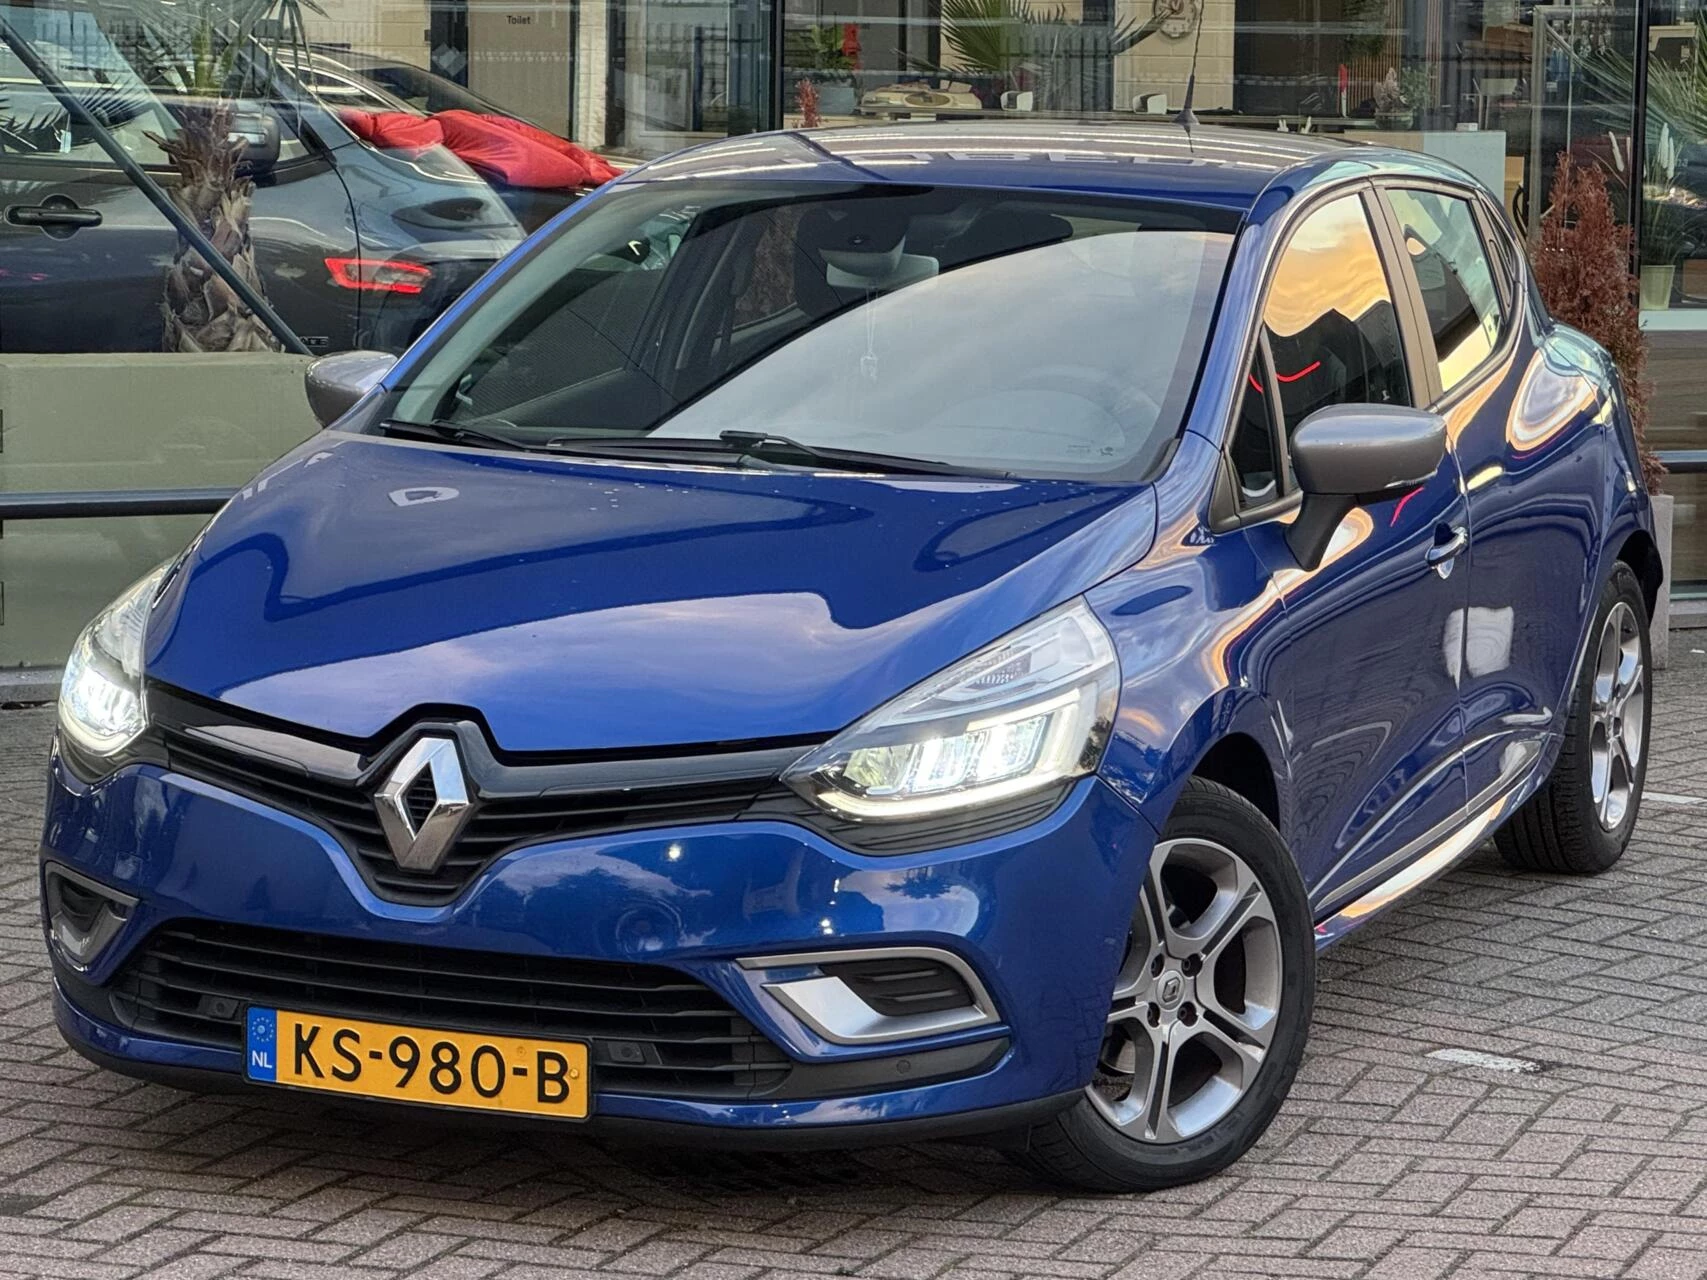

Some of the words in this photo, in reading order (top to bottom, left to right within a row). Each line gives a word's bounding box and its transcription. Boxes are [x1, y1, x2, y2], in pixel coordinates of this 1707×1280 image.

[506, 15, 531, 25] Toilet
[251, 1050, 273, 1069] NL
[294, 1022, 571, 1105] KS-980-B
